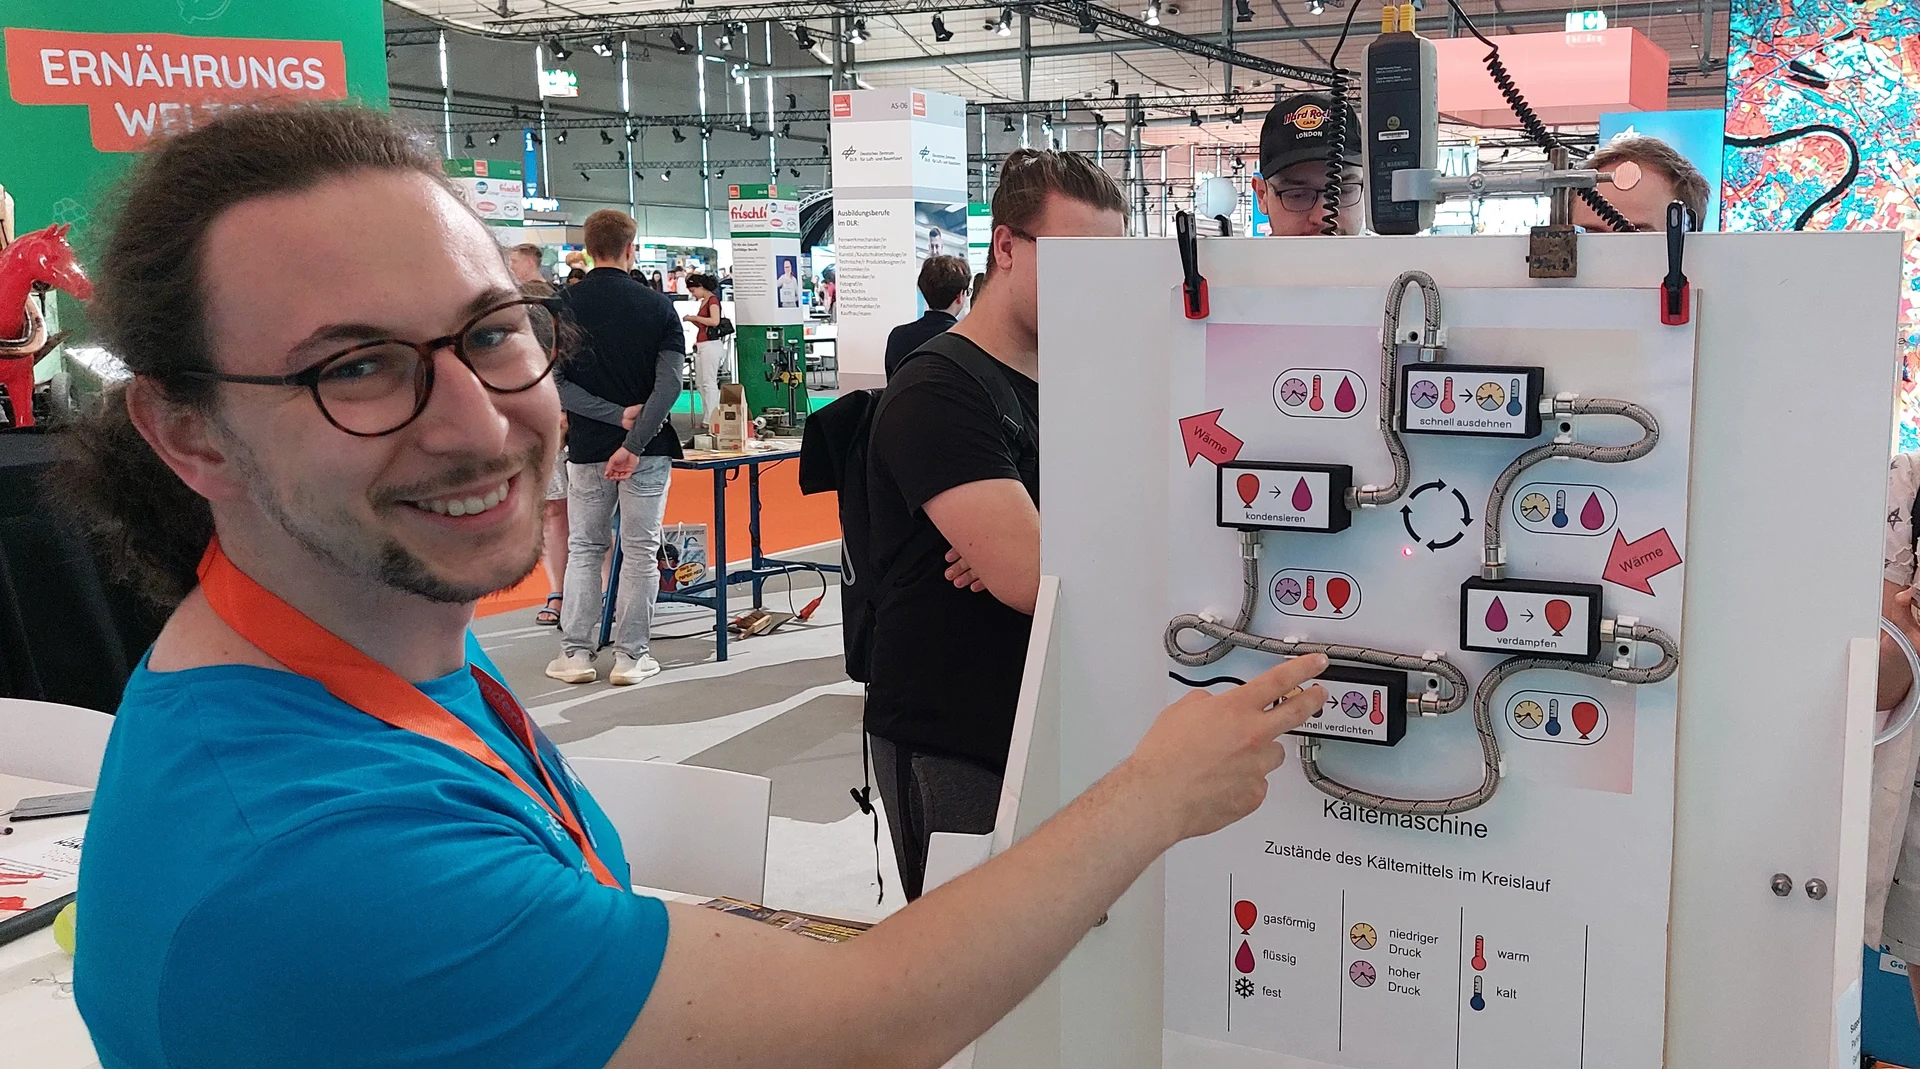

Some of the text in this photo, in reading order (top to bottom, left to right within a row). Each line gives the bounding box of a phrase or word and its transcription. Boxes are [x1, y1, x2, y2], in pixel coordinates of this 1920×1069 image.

[39, 43, 326, 91] ERNÄHRUNGS
[1283, 109, 1308, 125] Hard
[1296, 131, 1323, 139] LONDON
[731, 203, 769, 219] frischli
[838, 209, 890, 217] Ausbildungsberufe
[1419, 417, 1512, 428] schnell ausdehnen
[1193, 425, 1228, 455] Wärme
[1245, 511, 1306, 523] kondensieren
[1618, 547, 1664, 573] Wärme
[1496, 635, 1557, 648] verdampfen
[1324, 725, 1374, 735] verdichten
[1323, 798, 1488, 838] Kältemaschine
[1264, 840, 1551, 893] Zustände des Kältemittels im Kreislauf
[1262, 913, 1316, 932] gasförmig
[1389, 928, 1439, 945] niedriger
[1262, 949, 1297, 966] flüssig
[1389, 944, 1422, 958] Druck
[1497, 950, 1530, 963] warm
[1388, 966, 1421, 980] hoher
[1262, 986, 1282, 999] fest
[1388, 982, 1421, 996] Druck
[1496, 987, 1518, 1000] kalt
